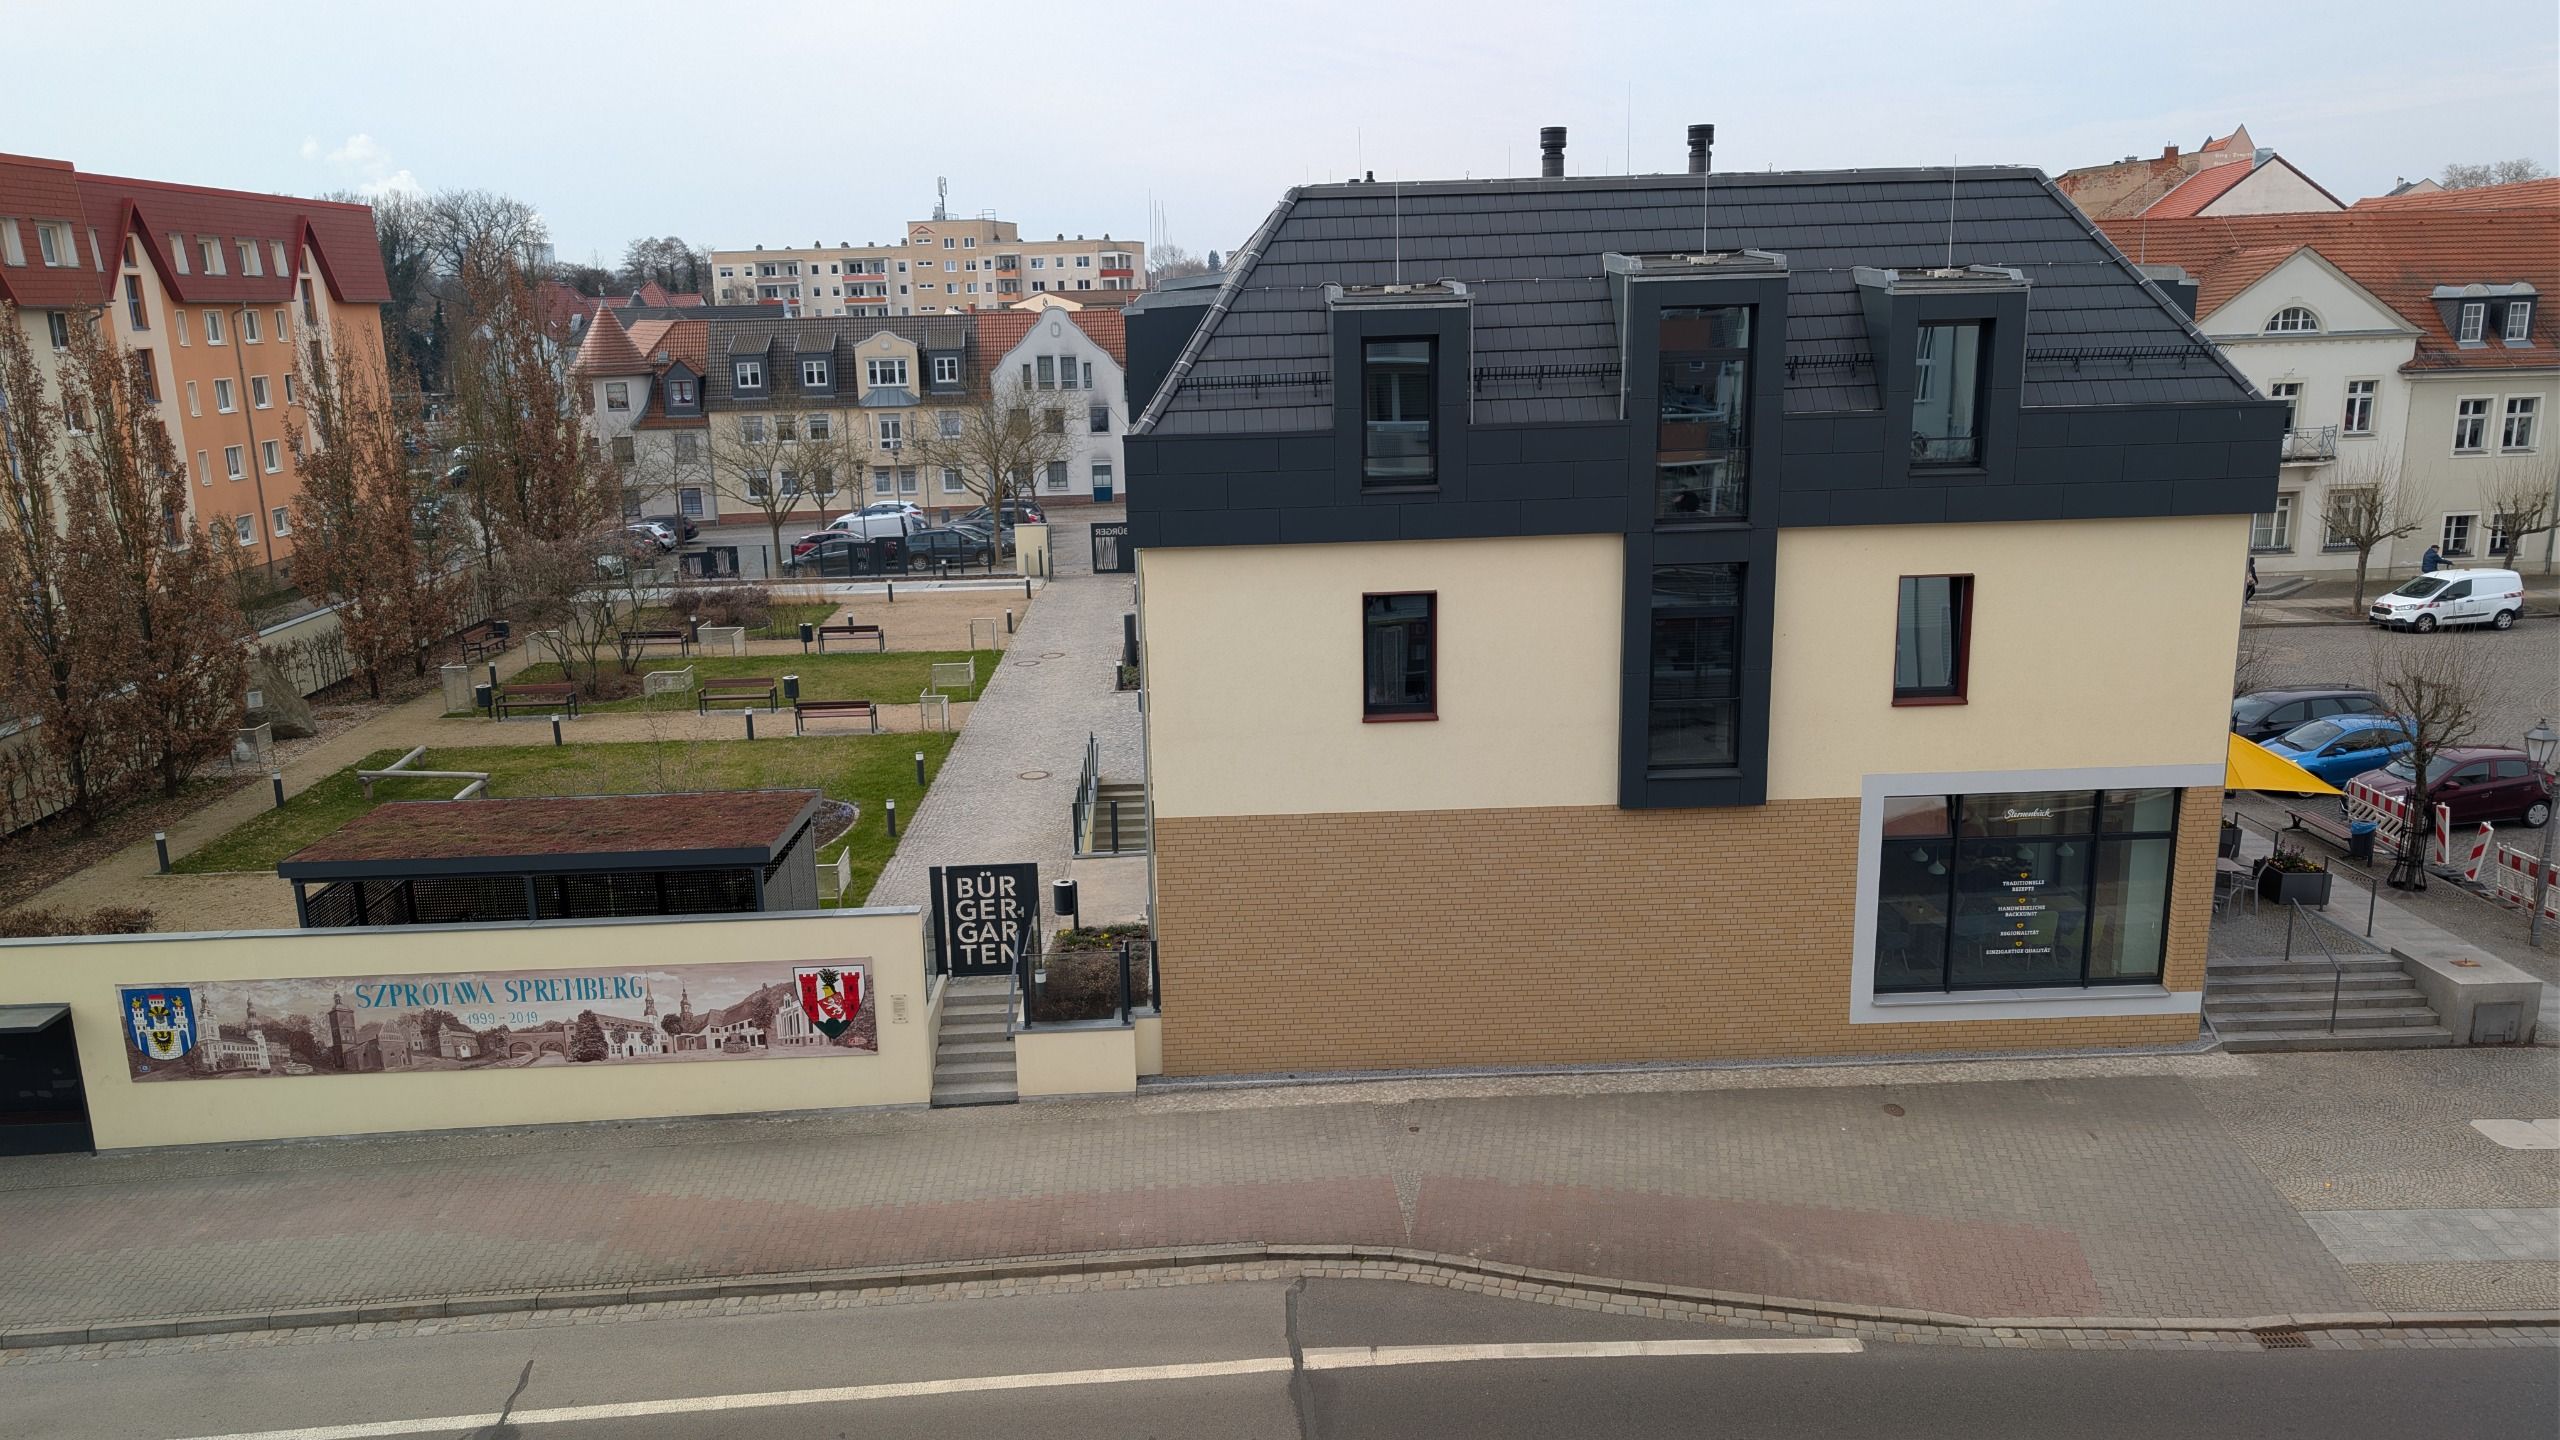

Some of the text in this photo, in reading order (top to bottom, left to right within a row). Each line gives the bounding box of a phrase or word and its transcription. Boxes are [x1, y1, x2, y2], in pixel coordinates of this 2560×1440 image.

[957, 871, 1017, 899] BÜR
[957, 920, 1018, 944] GAR
[959, 943, 1019, 966] TEN
[355, 975, 644, 1009] SZPROTAWA SPREMBERG
[466, 1012, 496, 1026] 1999
[508, 1011, 539, 1025] 2019
